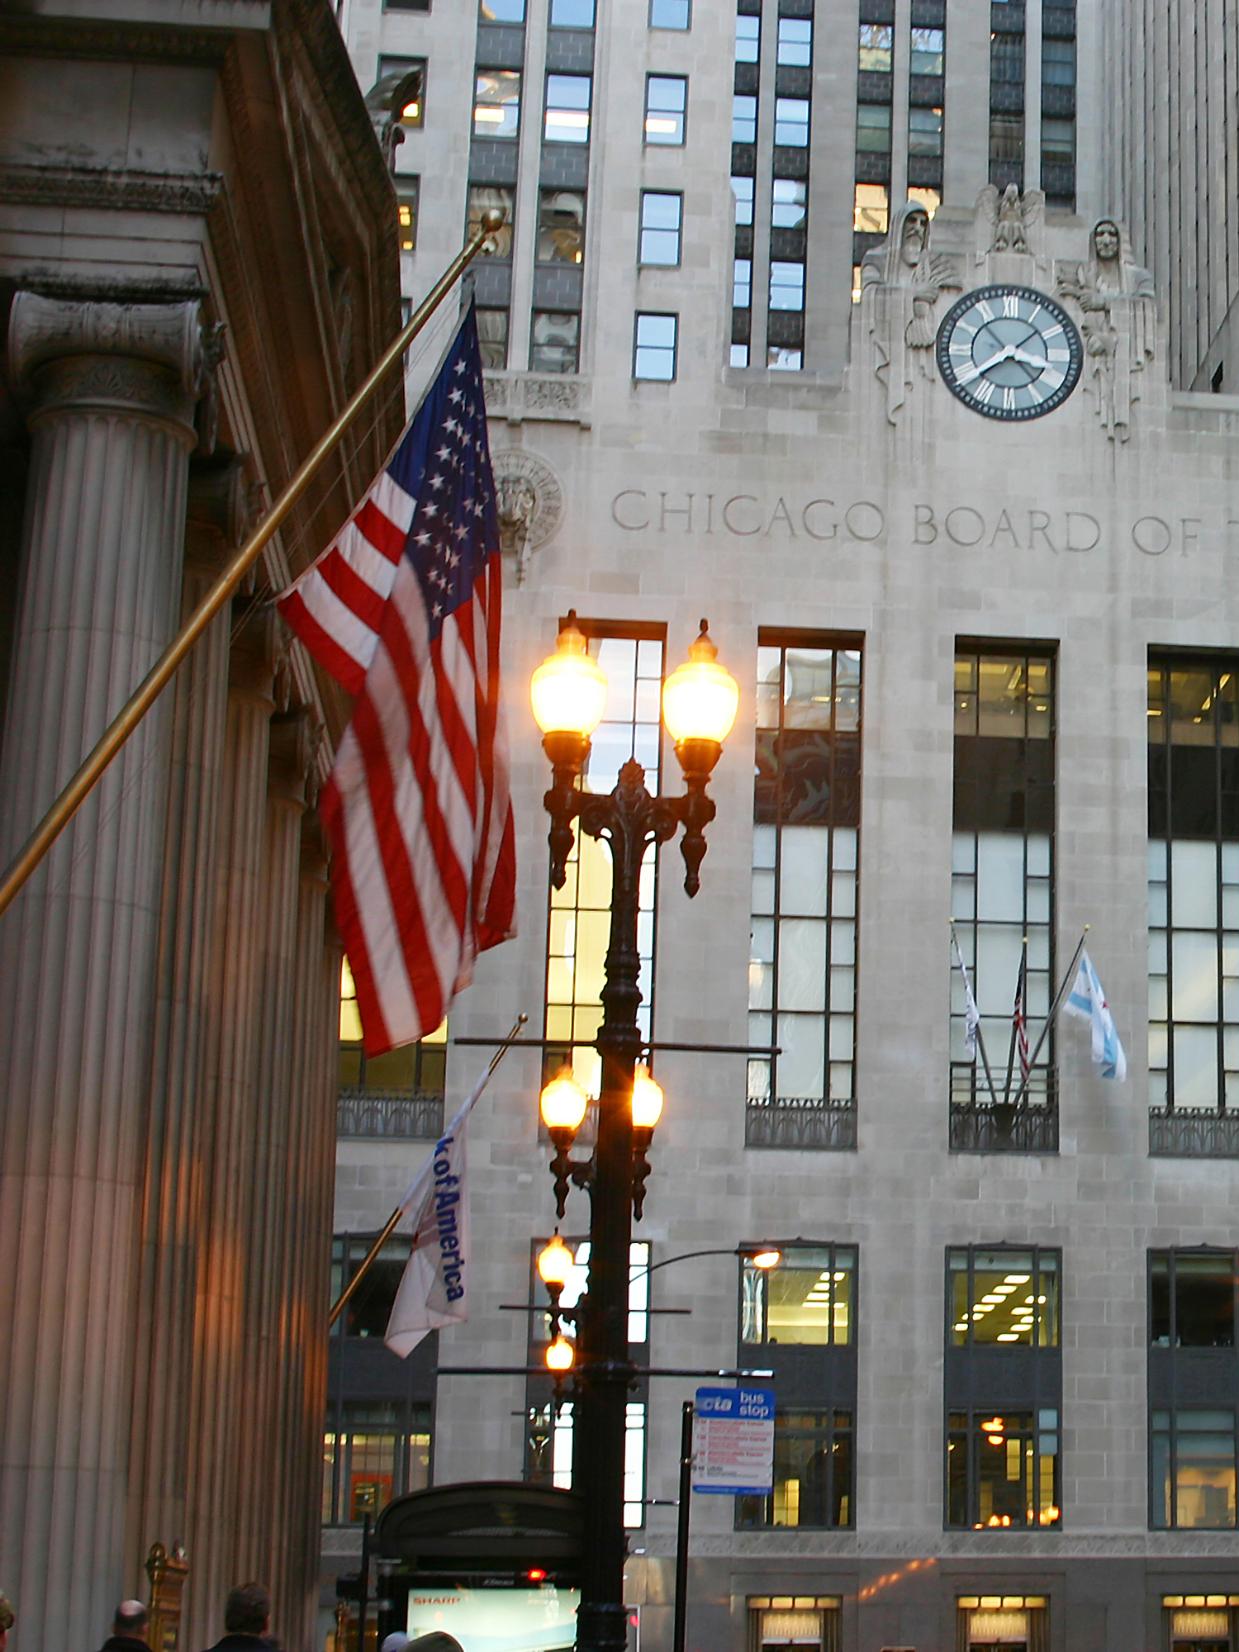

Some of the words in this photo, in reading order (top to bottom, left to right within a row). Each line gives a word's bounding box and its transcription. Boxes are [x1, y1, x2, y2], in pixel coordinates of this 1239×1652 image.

[1003, 295, 1018, 317] XII
[611, 489, 884, 541] CHICAGO
[913, 504, 1101, 554] BOARD
[1132, 516, 1200, 558] OF
[433, 1163, 459, 1187] of
[436, 1191, 465, 1303] America
[740, 1391, 764, 1404] bus
[740, 1405, 769, 1417] stop
[414, 1597, 460, 1605] SHARP
